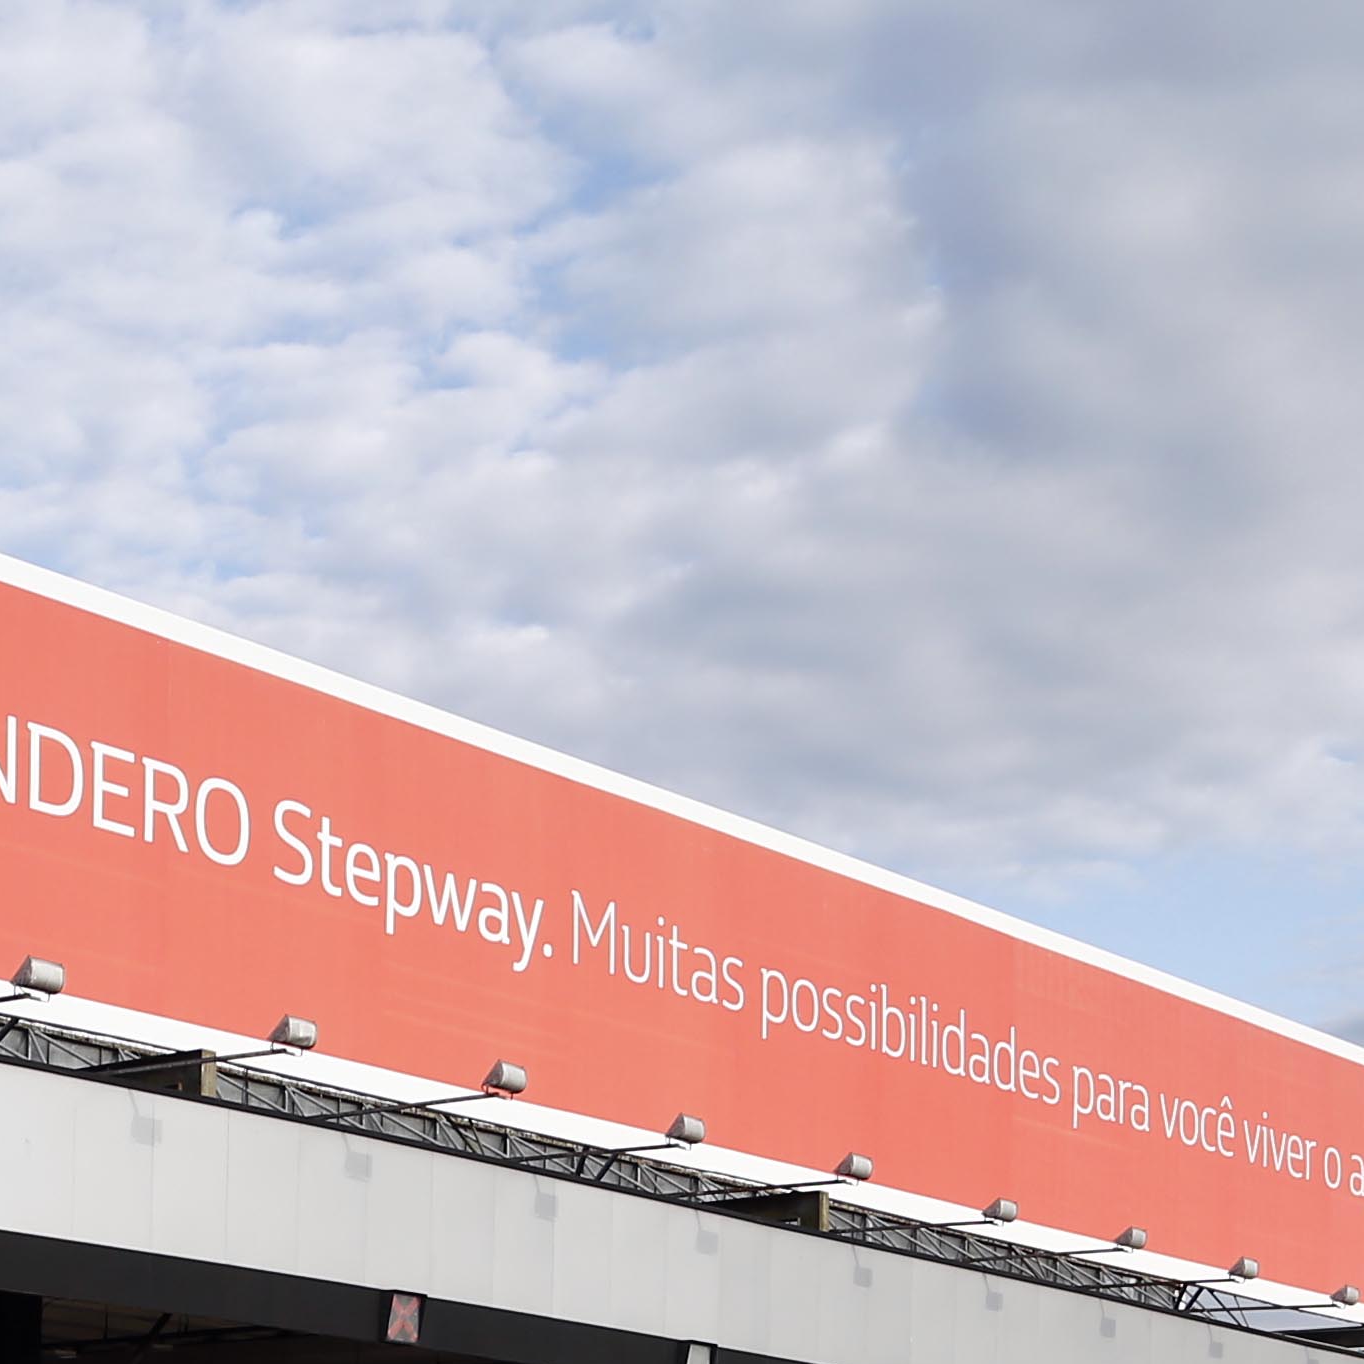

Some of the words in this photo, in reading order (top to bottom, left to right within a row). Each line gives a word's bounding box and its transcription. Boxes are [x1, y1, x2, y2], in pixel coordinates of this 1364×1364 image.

[273, 799, 553, 973] Stepway.
[571, 889, 744, 1011] Muitas
[760, 967, 1060, 1105] possibilidades
[1072, 1065, 1150, 1132] para
[1160, 1094, 1235, 1157] você
[1243, 1112, 1317, 1181] viver
[1324, 1147, 1342, 1189] o
